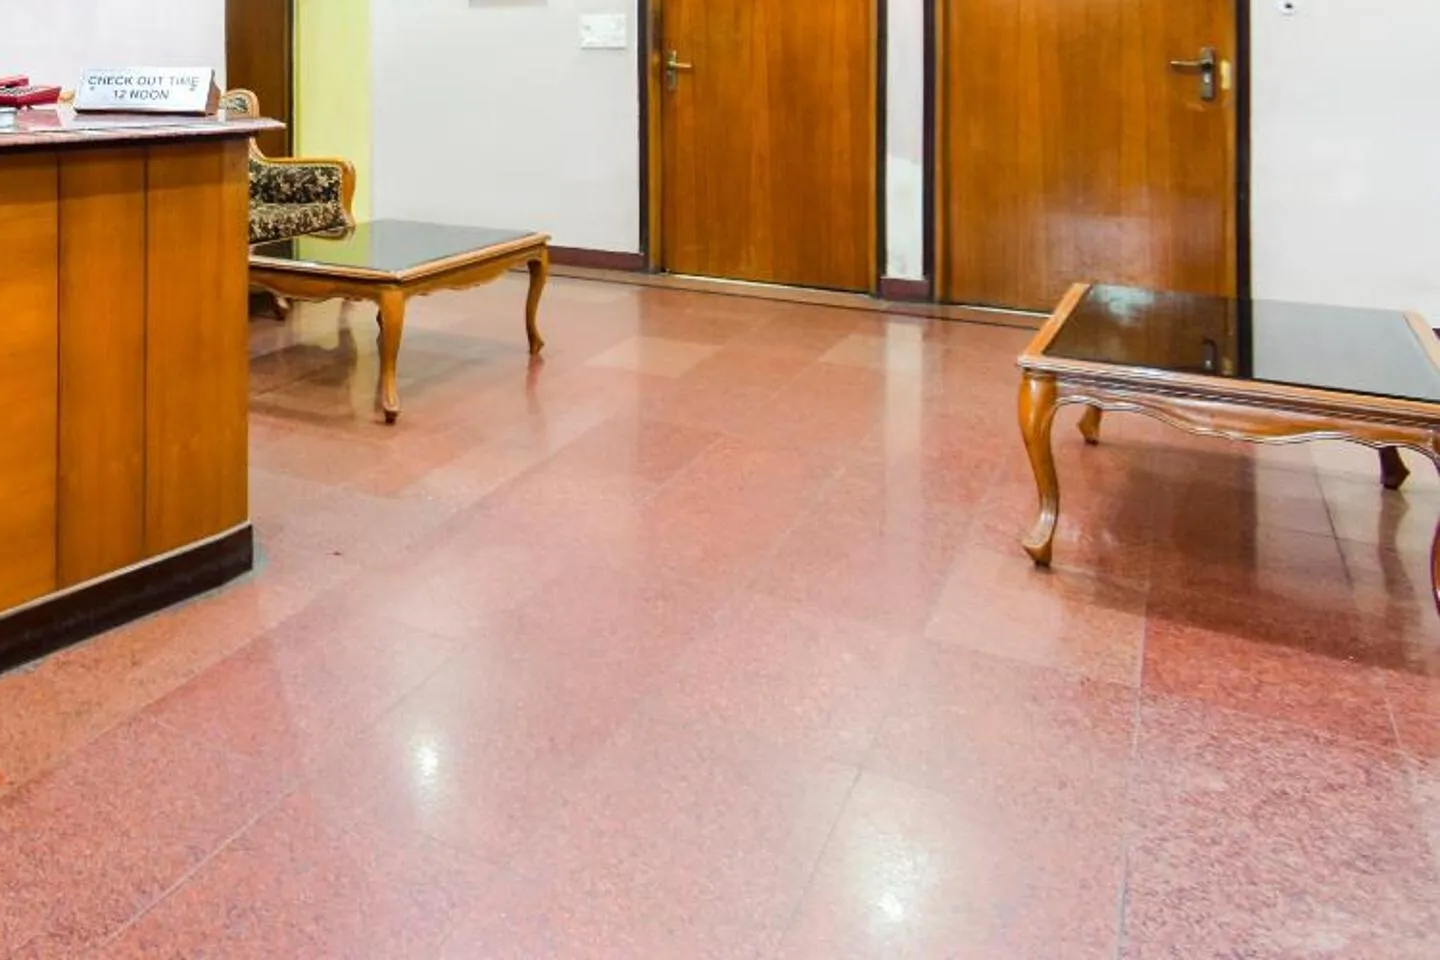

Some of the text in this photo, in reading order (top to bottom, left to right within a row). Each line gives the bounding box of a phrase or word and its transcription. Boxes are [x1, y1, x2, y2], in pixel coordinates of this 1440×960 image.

[87, 76, 200, 87] CHECK OUT TIME
[113, 89, 170, 100] 12 NOON
